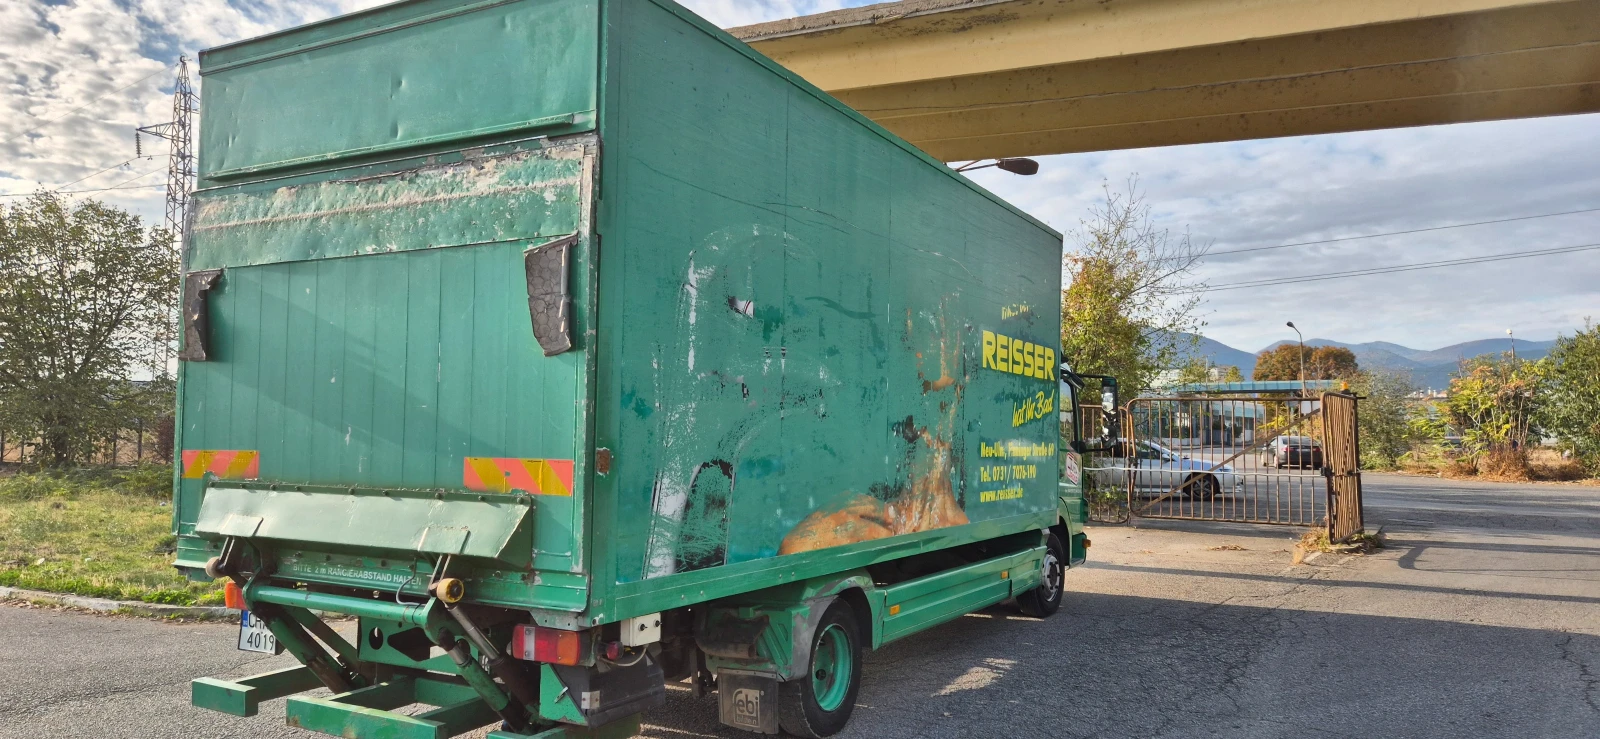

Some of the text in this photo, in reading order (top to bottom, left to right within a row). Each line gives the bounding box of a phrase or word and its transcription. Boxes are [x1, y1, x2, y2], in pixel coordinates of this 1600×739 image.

[983, 330, 1055, 381] REISSER
[1035, 389, 1055, 419] Bad
[980, 441, 1007, 460] Neu-Ulm,
[980, 465, 991, 482] Tel.
[1012, 464, 1037, 480] 7076-190
[980, 483, 1023, 502] www.reisser.de
[293, 563, 312, 573] BITTE
[327, 568, 392, 582] RANGIERABSTAND
[393, 575, 422, 586] HALTEN
[247, 631, 275, 651] 4019
[734, 690, 758, 715] febi
